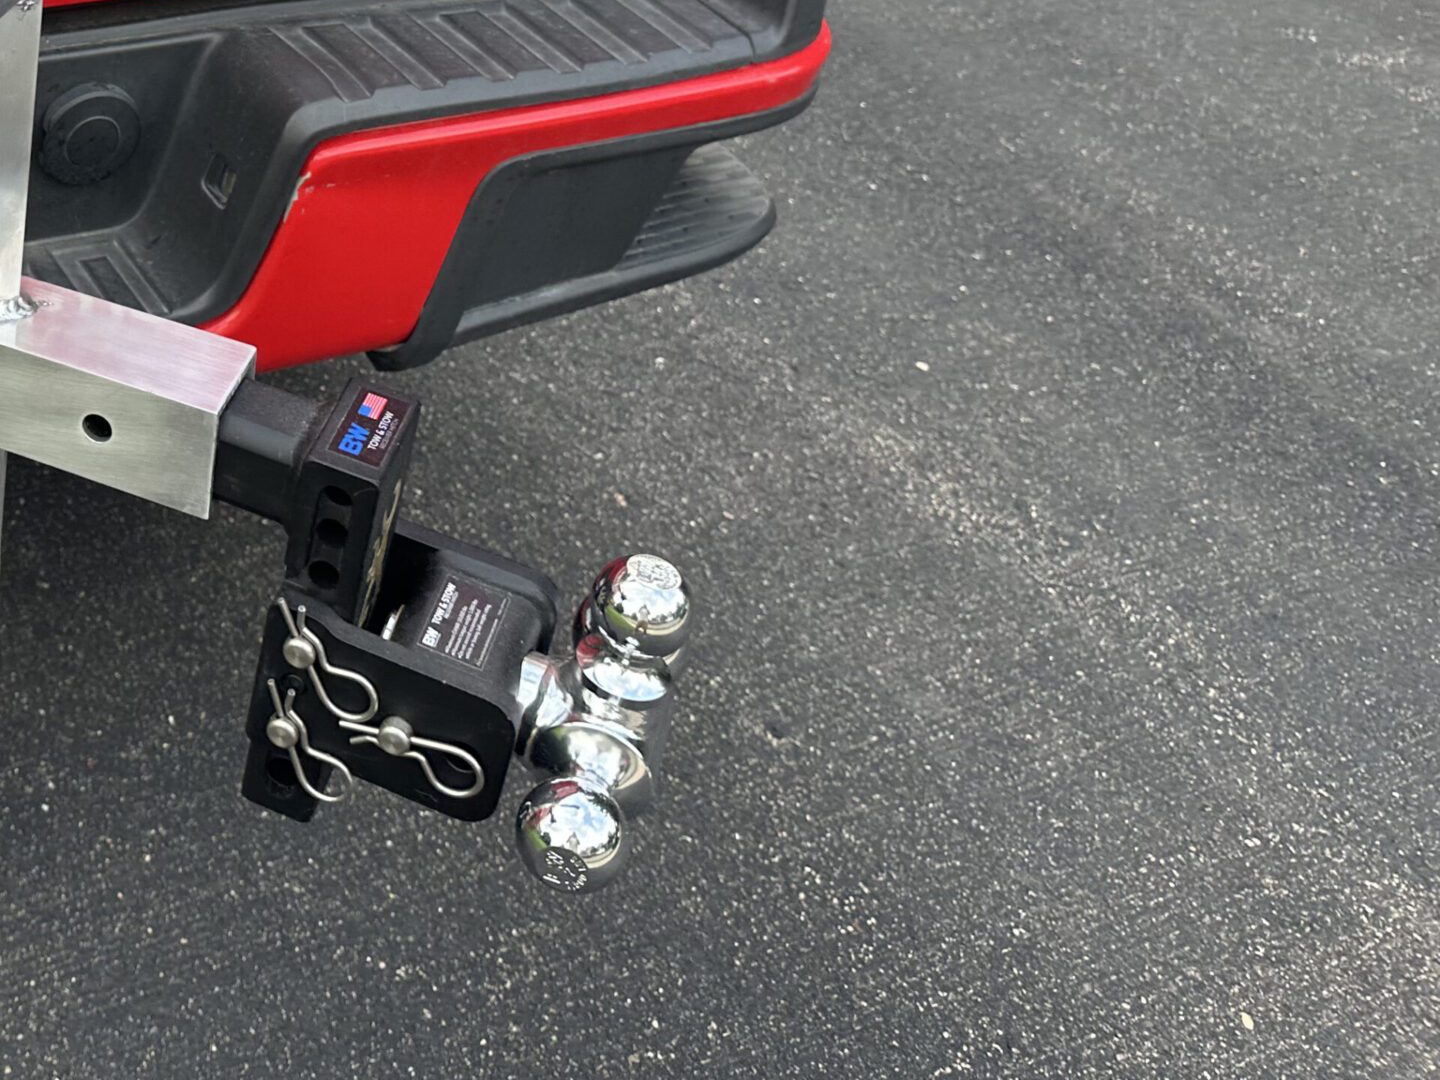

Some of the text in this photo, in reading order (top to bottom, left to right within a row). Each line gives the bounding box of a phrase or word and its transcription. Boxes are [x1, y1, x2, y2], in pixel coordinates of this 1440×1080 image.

[339, 422, 369, 456] BW
[367, 433, 382, 450] TOW
[379, 411, 394, 429] STOW
[432, 607, 445, 624] TOW
[441, 582, 456, 602] STOW
